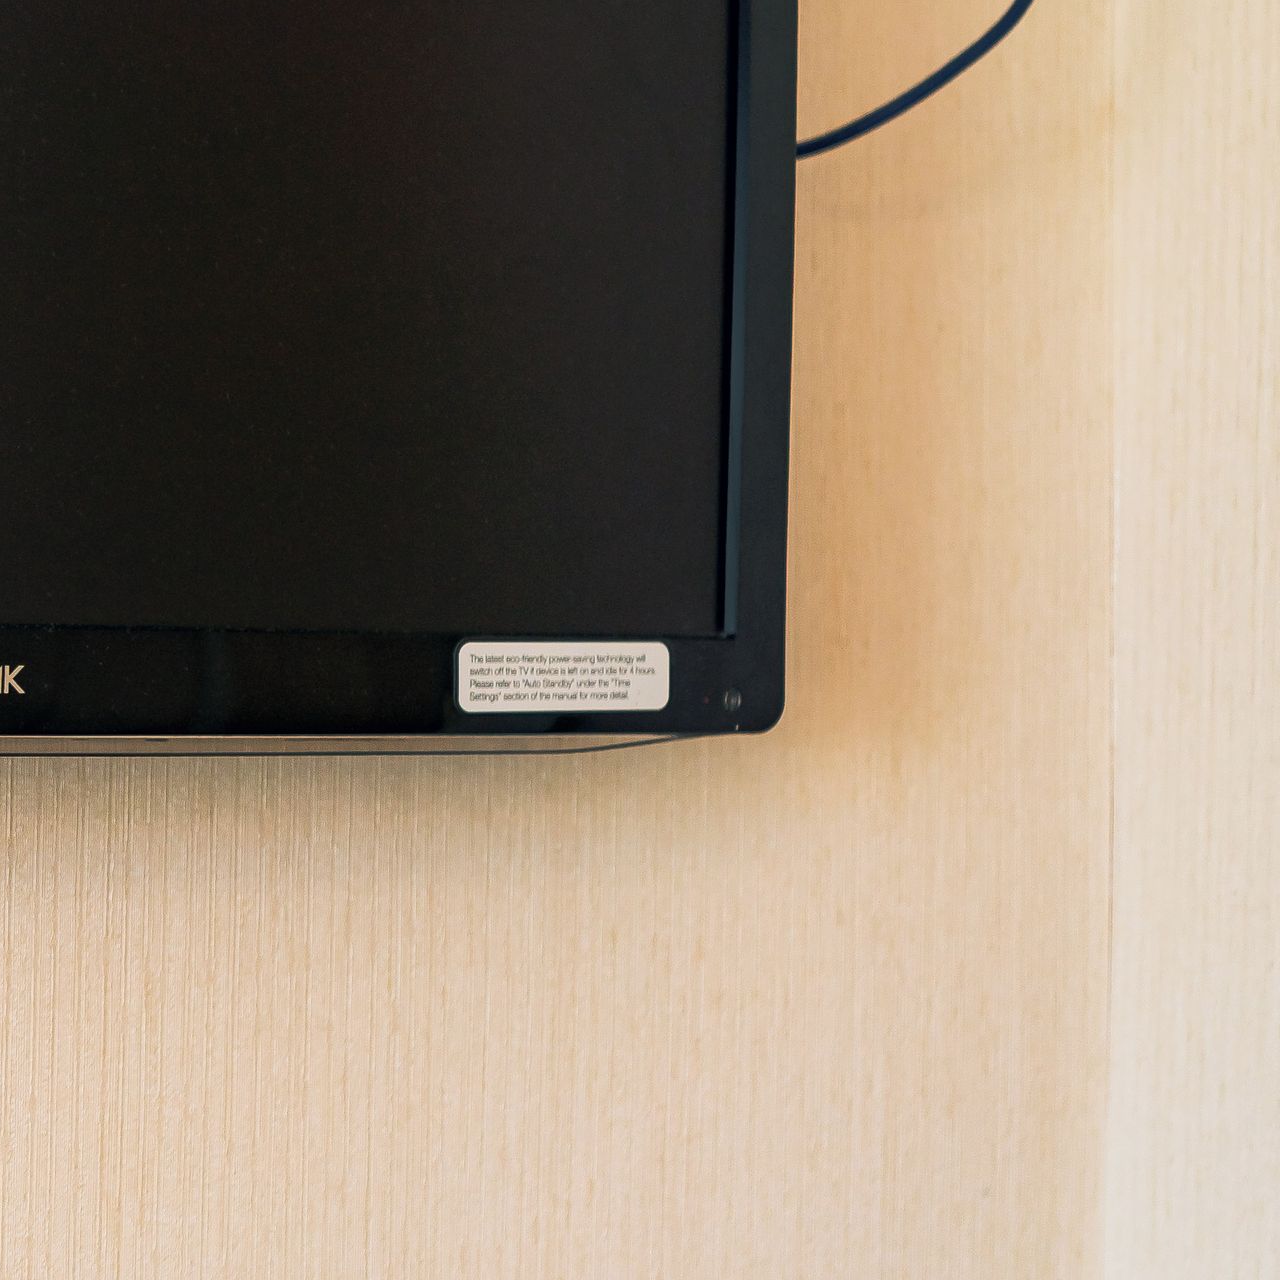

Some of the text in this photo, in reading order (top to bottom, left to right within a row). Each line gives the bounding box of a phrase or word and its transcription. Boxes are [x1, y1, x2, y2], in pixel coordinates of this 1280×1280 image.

[470, 653, 483, 663] The
[485, 653, 504, 663] latest
[597, 653, 634, 664] technology
[636, 653, 646, 662] will
[470, 667, 493, 676] switch
[494, 666, 504, 676] off
[506, 667, 517, 676] the
[519, 666, 529, 676] TV
[537, 667, 558, 676] device
[568, 666, 579, 675] left
[591, 667, 604, 675] and
[606, 667, 617, 675] idle
[619, 667, 628, 675] for
[470, 679, 493, 688] Please
[495, 679, 511, 688] refer
[513, 679, 520, 688] to
[576, 679, 597, 687] under
[598, 679, 609, 687] the
[503, 692, 529, 700] section
